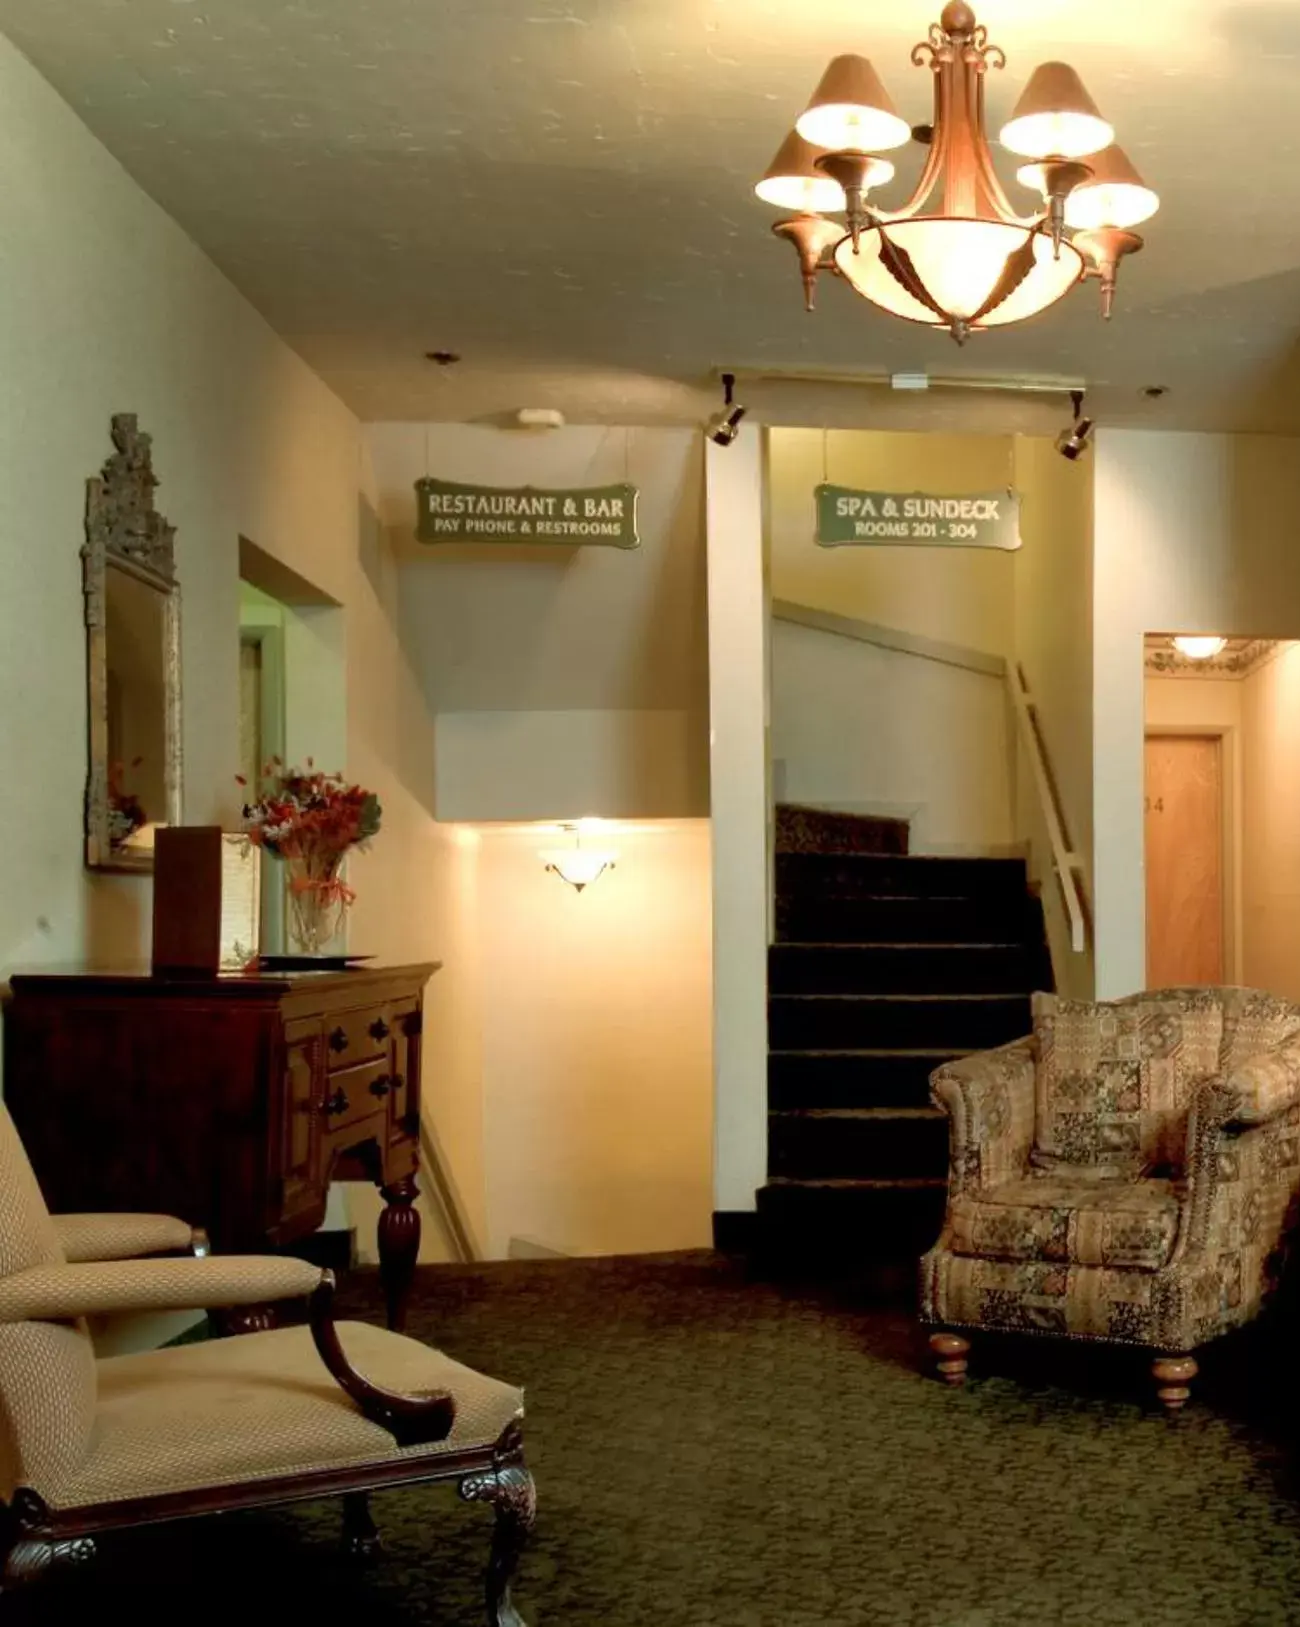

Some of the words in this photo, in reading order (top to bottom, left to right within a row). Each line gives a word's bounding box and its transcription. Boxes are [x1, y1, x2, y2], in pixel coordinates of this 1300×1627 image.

[428, 494, 555, 516] RESTAURANT
[562, 499, 577, 516] &
[584, 498, 624, 518] BAR
[836, 497, 879, 517] SPA
[882, 498, 898, 517] &
[903, 499, 1000, 520] SUNDECK
[434, 519, 460, 533] PAY
[465, 519, 516, 534] PHONE
[520, 521, 531, 534] &
[536, 521, 621, 536] RESTROOMS
[855, 521, 908, 537] ROOMS
[912, 522, 937, 538] 201
[949, 523, 977, 539] 304
